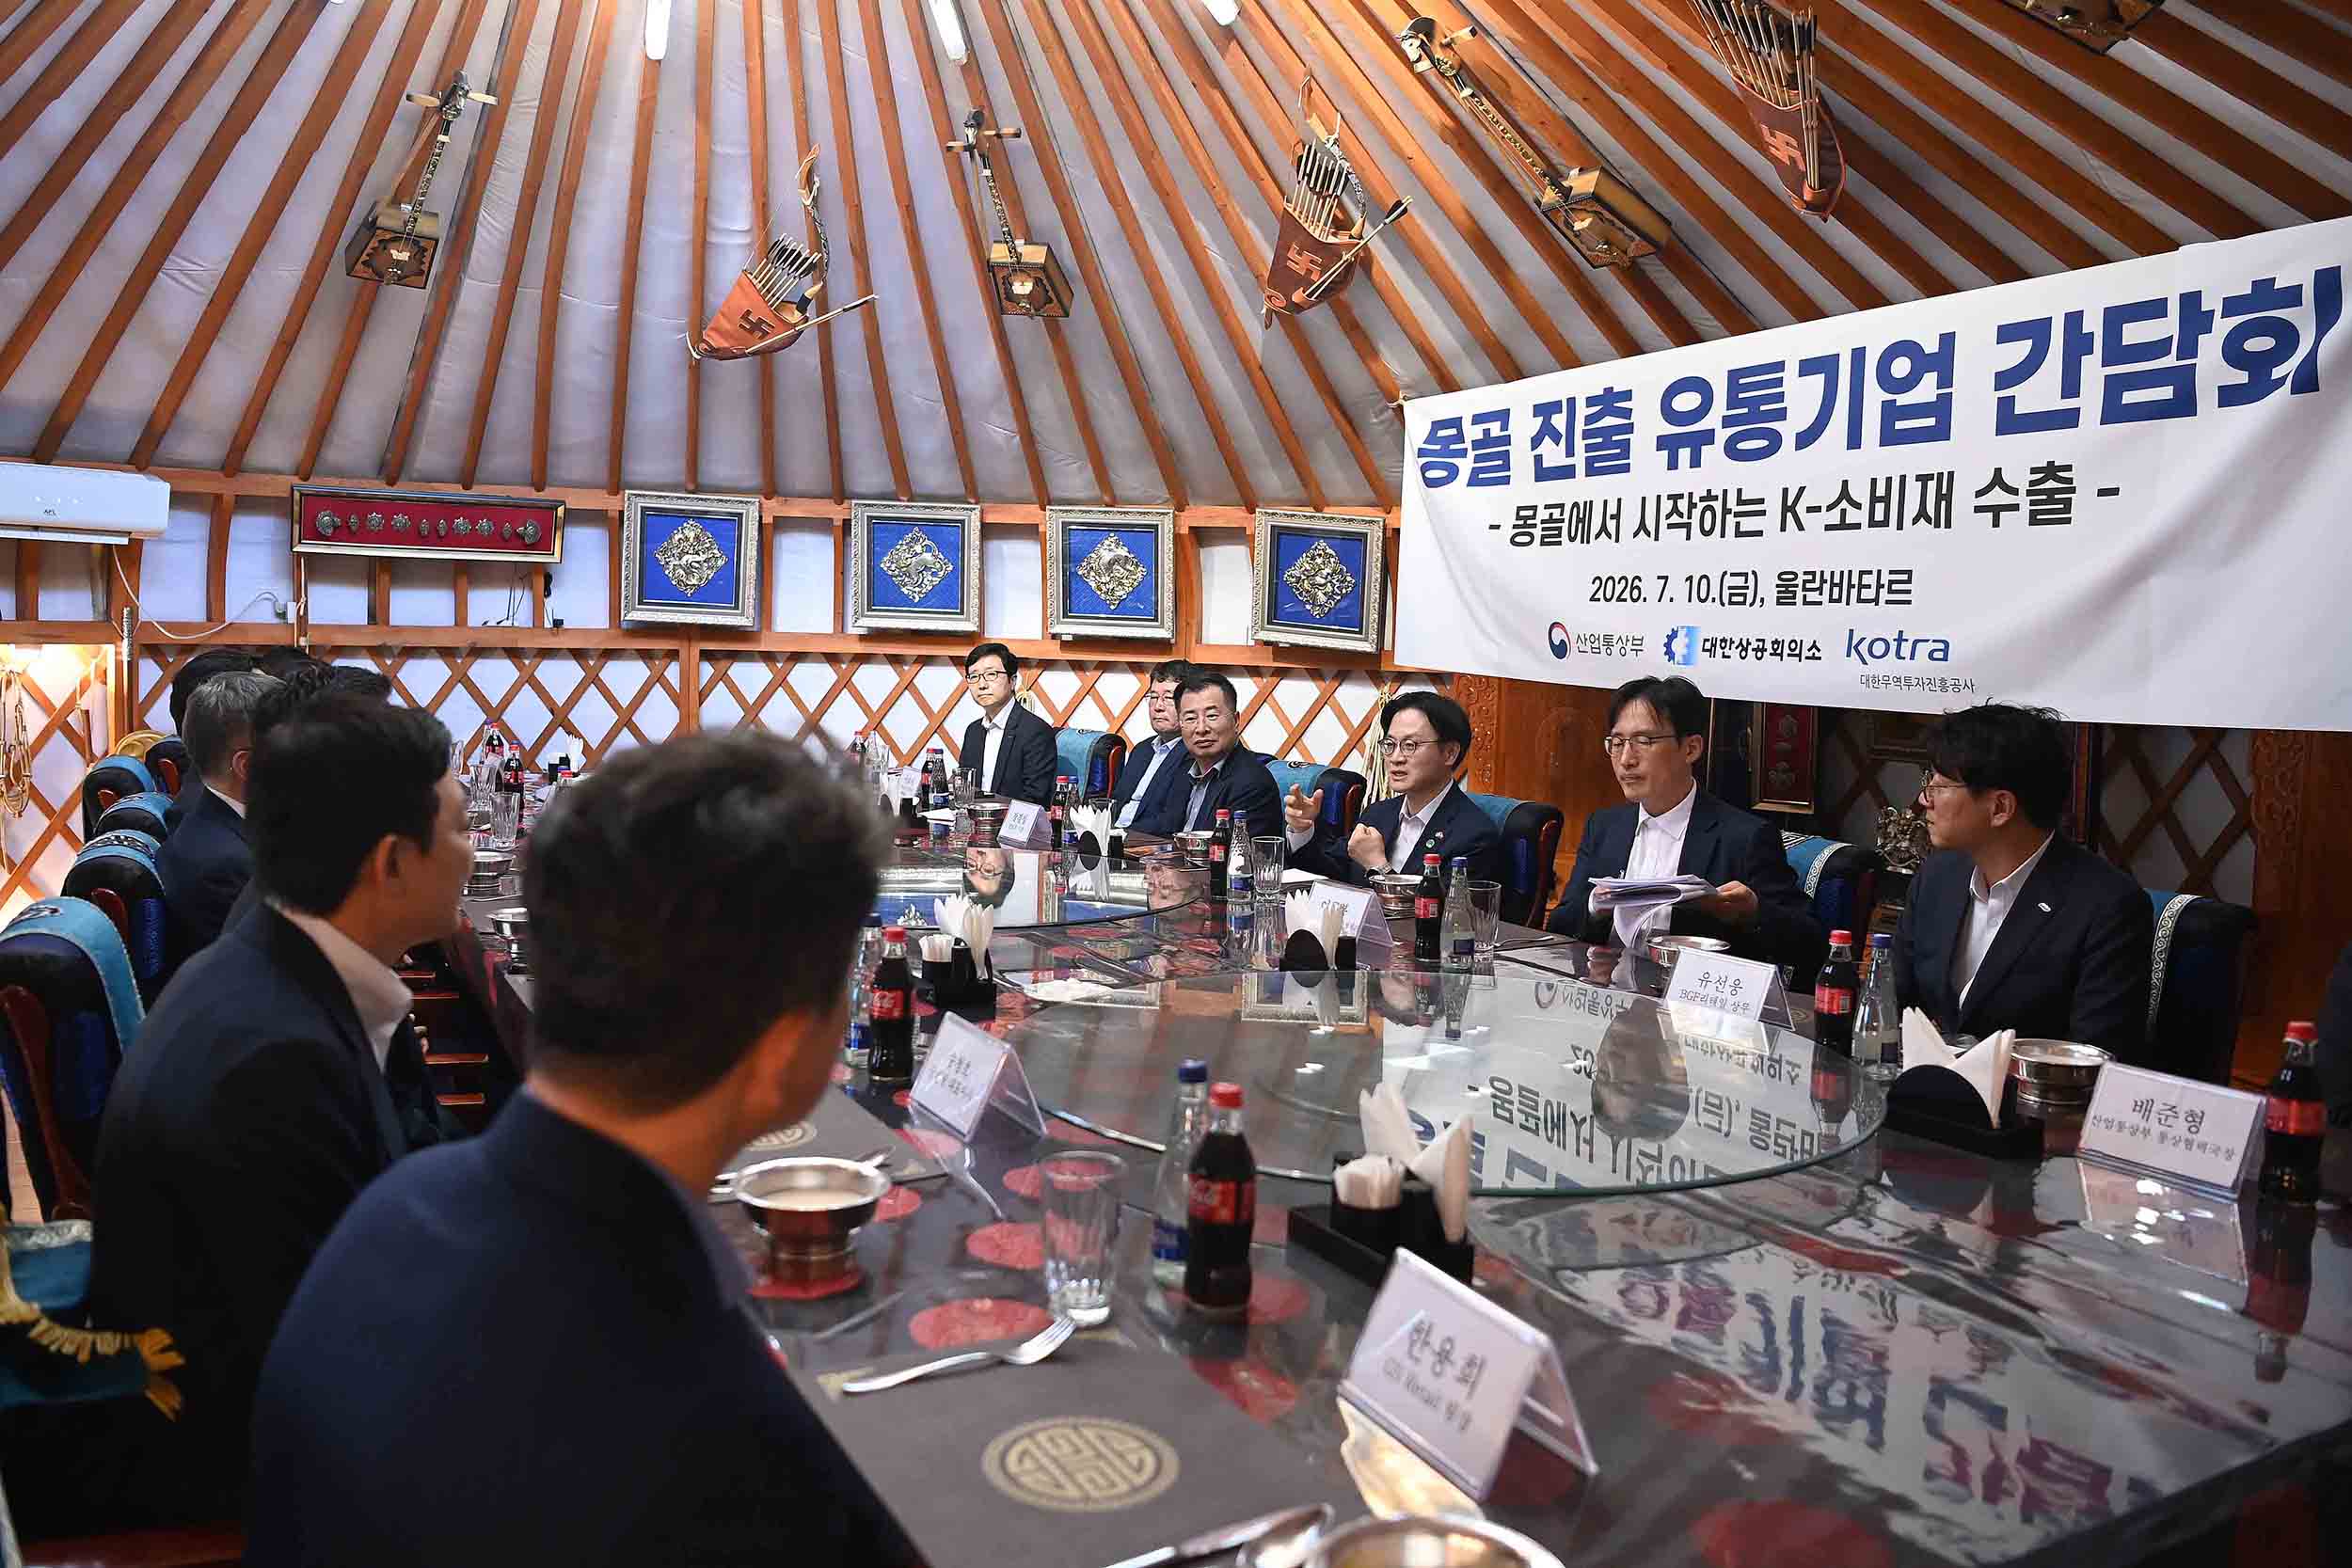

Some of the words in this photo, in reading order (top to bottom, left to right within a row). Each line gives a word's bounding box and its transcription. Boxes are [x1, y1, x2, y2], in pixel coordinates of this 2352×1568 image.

[1417, 407, 1511, 488] 몽골
[1531, 386, 1634, 483] 진출
[1656, 331, 1957, 471] 유통기업
[1994, 264, 2343, 436] 간담회
[1509, 498, 1622, 547] 몽골에서
[1632, 487, 1768, 541] 시작하는
[1779, 470, 1955, 532] K-소비재
[1973, 460, 2074, 529] 수출
[1589, 575, 1647, 604] 2026.
[1656, 575, 1674, 603] 7.
[1684, 569, 1766, 608] 10.(금),
[1775, 568, 1914, 608] 울란바타르
[1575, 632, 1645, 657] 산업통상부
[1701, 636, 1822, 663] 대한상공회의소
[1846, 628, 1950, 666] kotra
[1860, 673, 1976, 694] 대한무역투자진흥공사
[2131, 1099, 2205, 1135] 배준형
